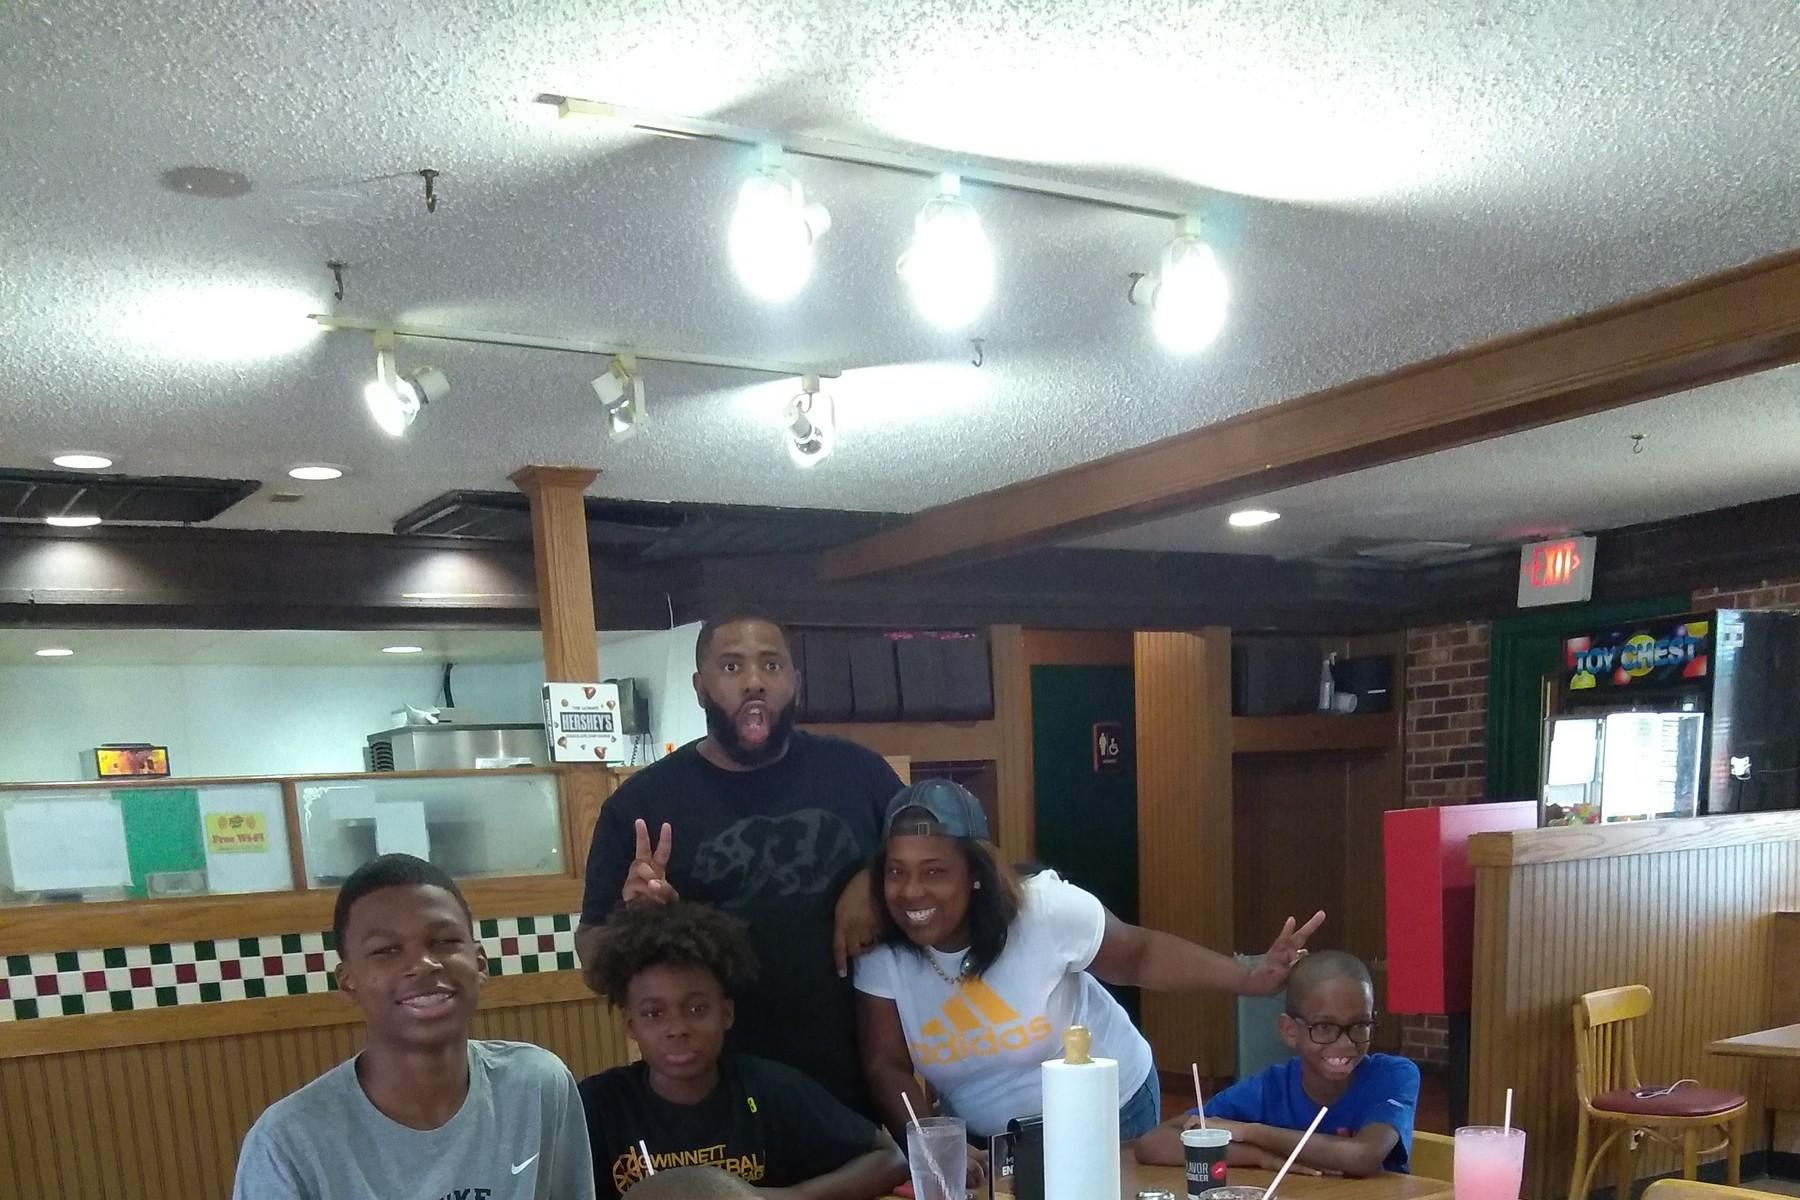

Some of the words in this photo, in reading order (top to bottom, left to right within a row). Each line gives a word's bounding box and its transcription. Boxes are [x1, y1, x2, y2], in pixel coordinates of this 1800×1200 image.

[1575, 646, 1616, 675] TOY
[1621, 635, 1697, 670] CHEST
[561, 713, 613, 731] HERSHEY'S
[911, 1014, 1054, 1067] adidas
[637, 1144, 727, 1169] GWINNETT
